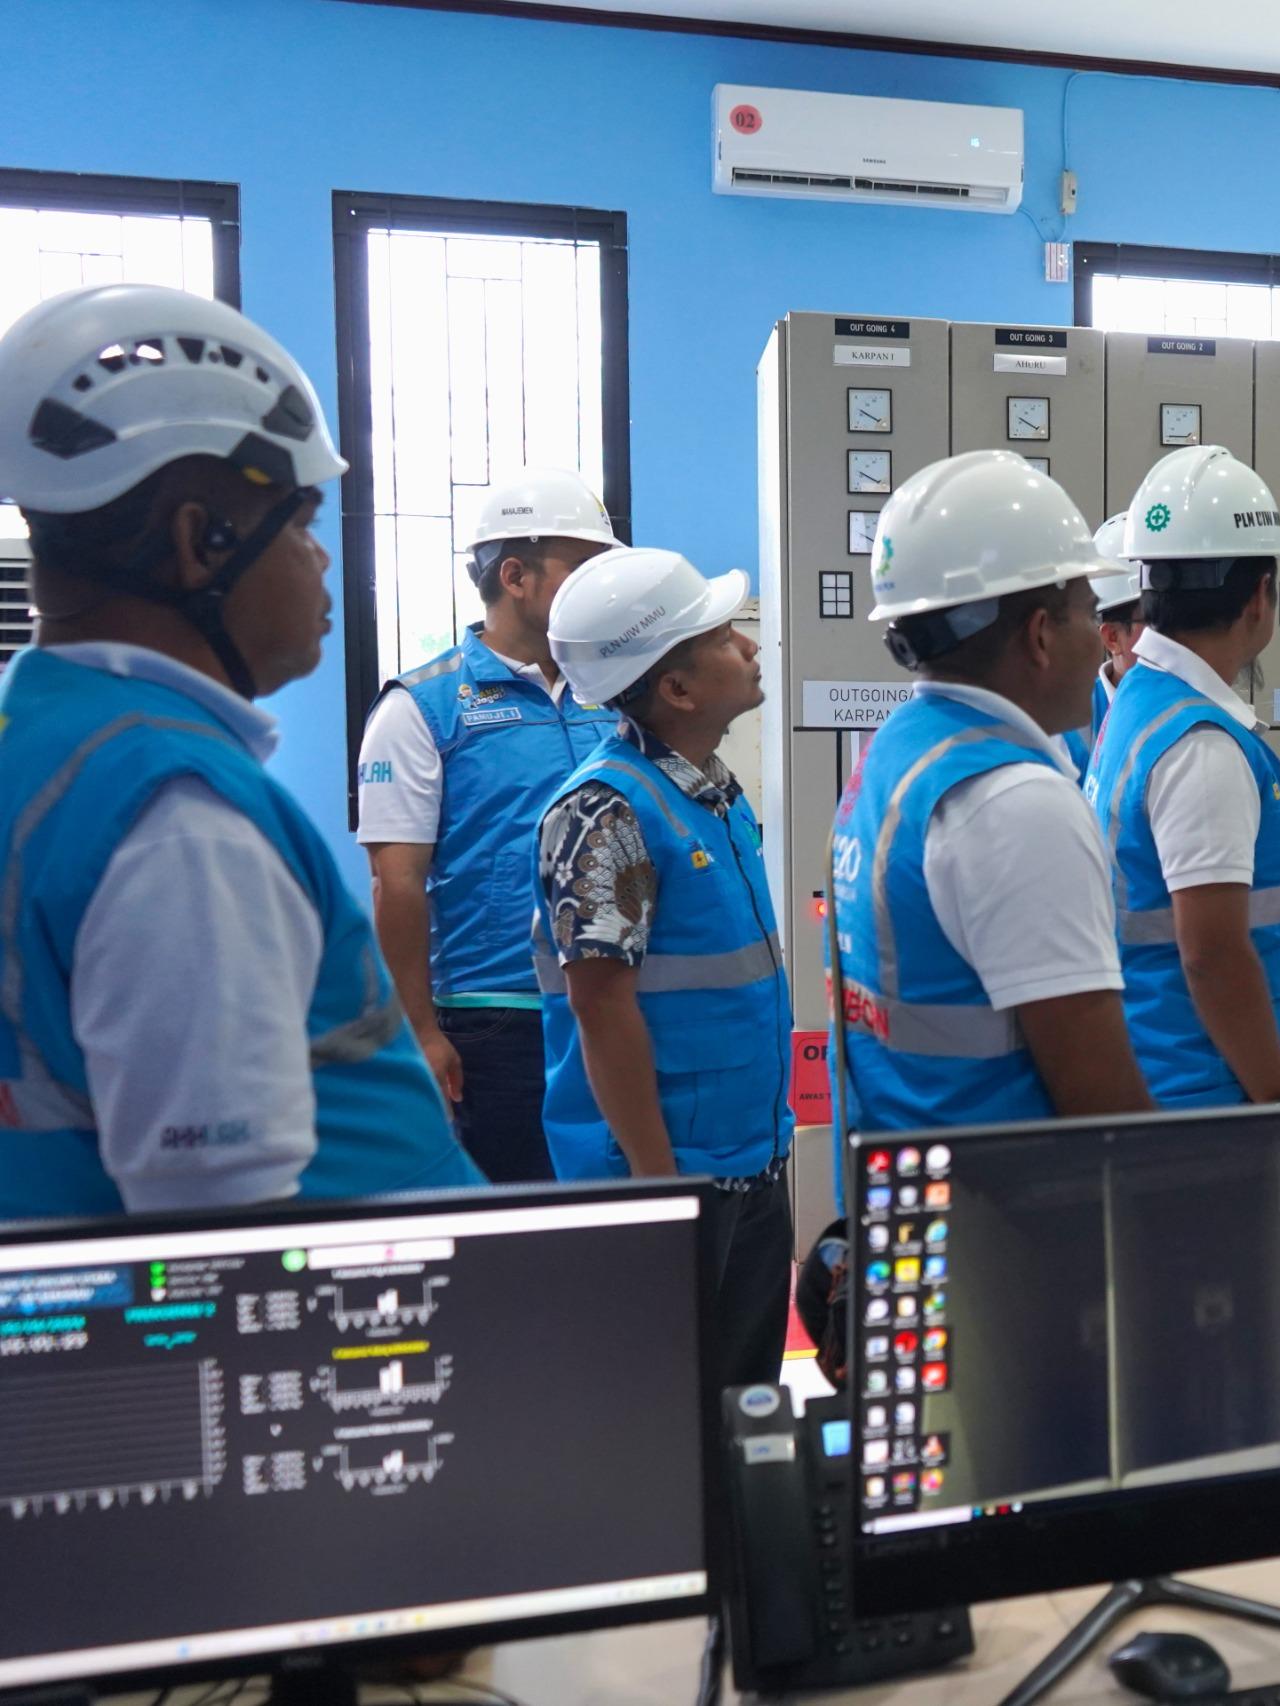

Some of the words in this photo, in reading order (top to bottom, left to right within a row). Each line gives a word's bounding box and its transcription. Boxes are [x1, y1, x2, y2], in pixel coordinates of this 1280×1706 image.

[735, 111, 755, 128] 02
[850, 323, 865, 332] OUT
[866, 324, 888, 333] GOING
[890, 325, 896, 333] 4
[1009, 333, 1023, 341] OUT
[1025, 334, 1046, 343] GOING
[1048, 335, 1054, 343] 3
[1161, 341, 1175, 350] OUT
[1176, 342, 1197, 351] GOING
[1199, 343, 1204, 351] 2
[852, 351, 889, 361] KARPAN
[1233, 511, 1255, 528] PLN
[600, 638, 621, 658] PLN
